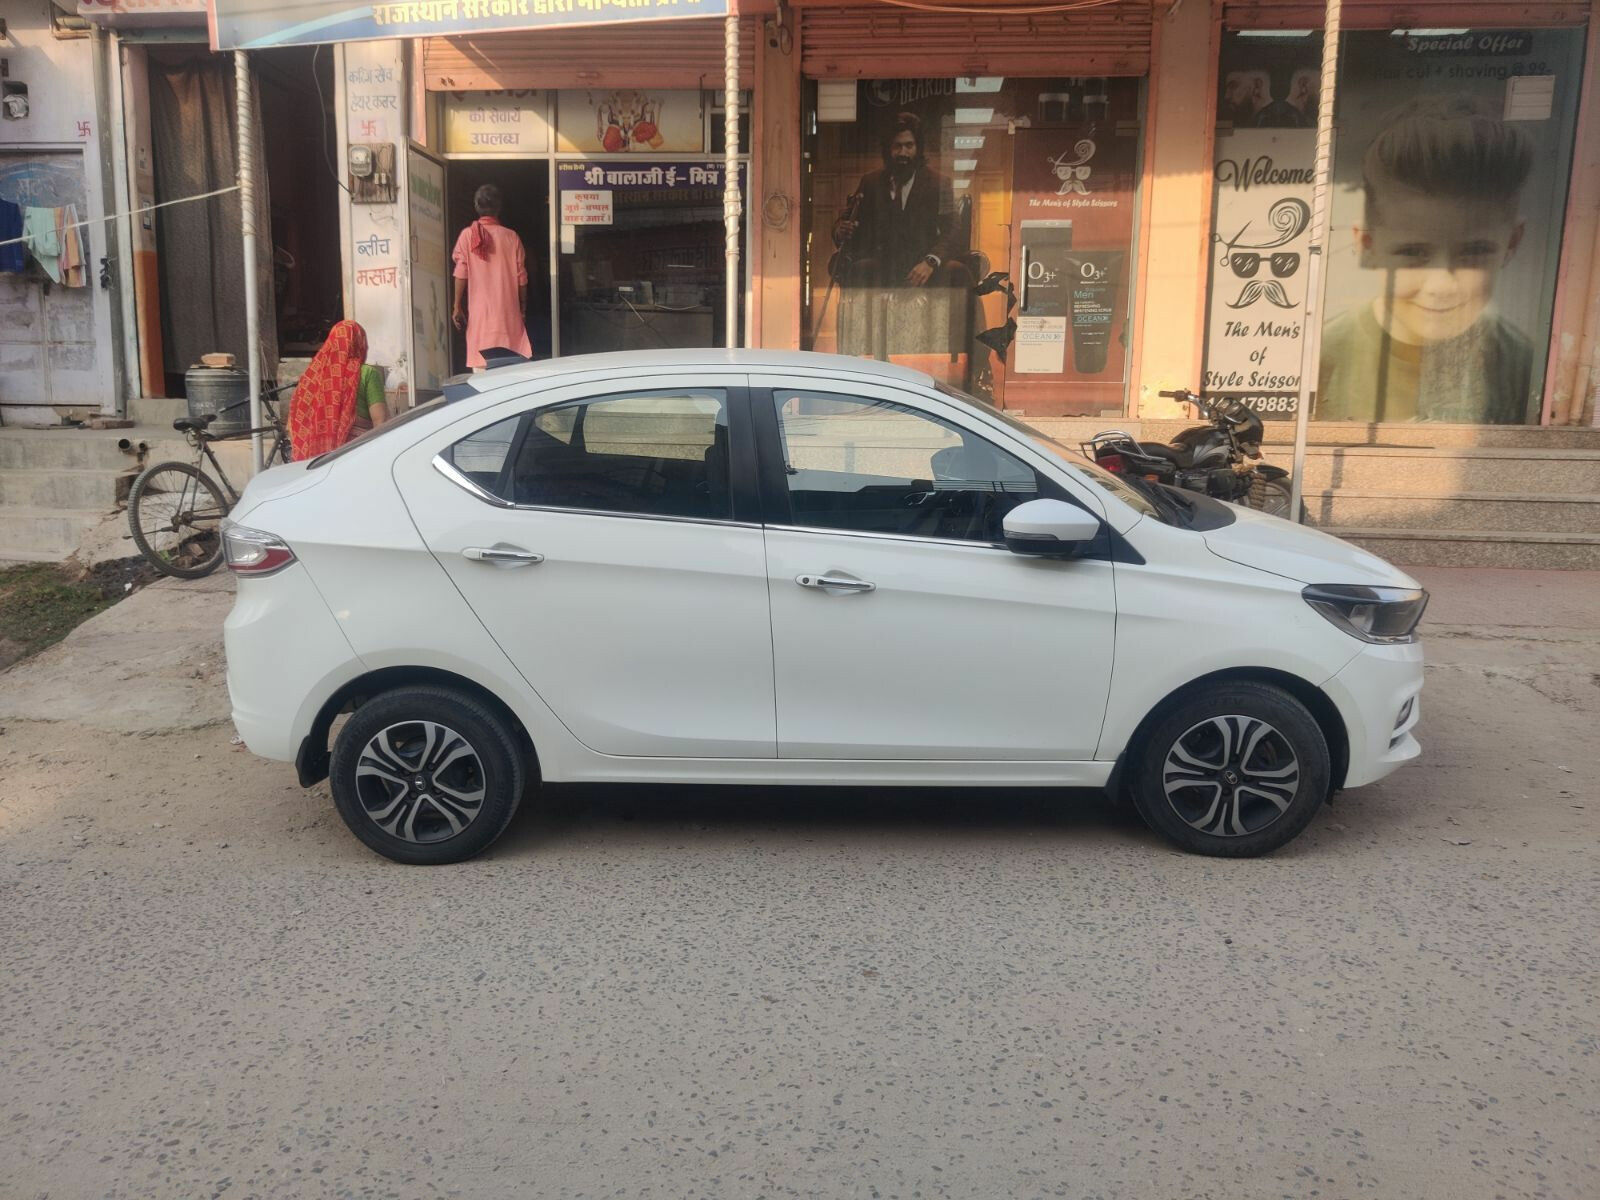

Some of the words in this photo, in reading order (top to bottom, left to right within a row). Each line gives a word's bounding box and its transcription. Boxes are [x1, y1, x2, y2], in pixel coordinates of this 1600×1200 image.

[374, 4, 459, 25] राजस्थान
[463, 0, 528, 19] सरकार
[1407, 36, 1475, 53] Special
[1478, 34, 1525, 53] Offer
[1448, 62, 1507, 81] shaving
[469, 106, 485, 123] की
[470, 132, 520, 146] उपलब्ध
[584, 166, 605, 186] श्री
[606, 166, 664, 186] बालाजी
[1214, 155, 1314, 192] Welcome
[1029, 199, 1041, 207] The
[1042, 199, 1062, 207] Men's
[1063, 199, 1071, 208] of
[1072, 199, 1090, 208] Style
[1091, 199, 1118, 208] Scissors
[356, 233, 391, 256] ब्लीच
[1073, 290, 1094, 299] Men
[1224, 321, 1249, 337] The
[1253, 321, 1300, 339] Men's
[1249, 346, 1268, 366] of
[1204, 371, 1244, 389] Style
[1248, 371, 1300, 388] Scissor
